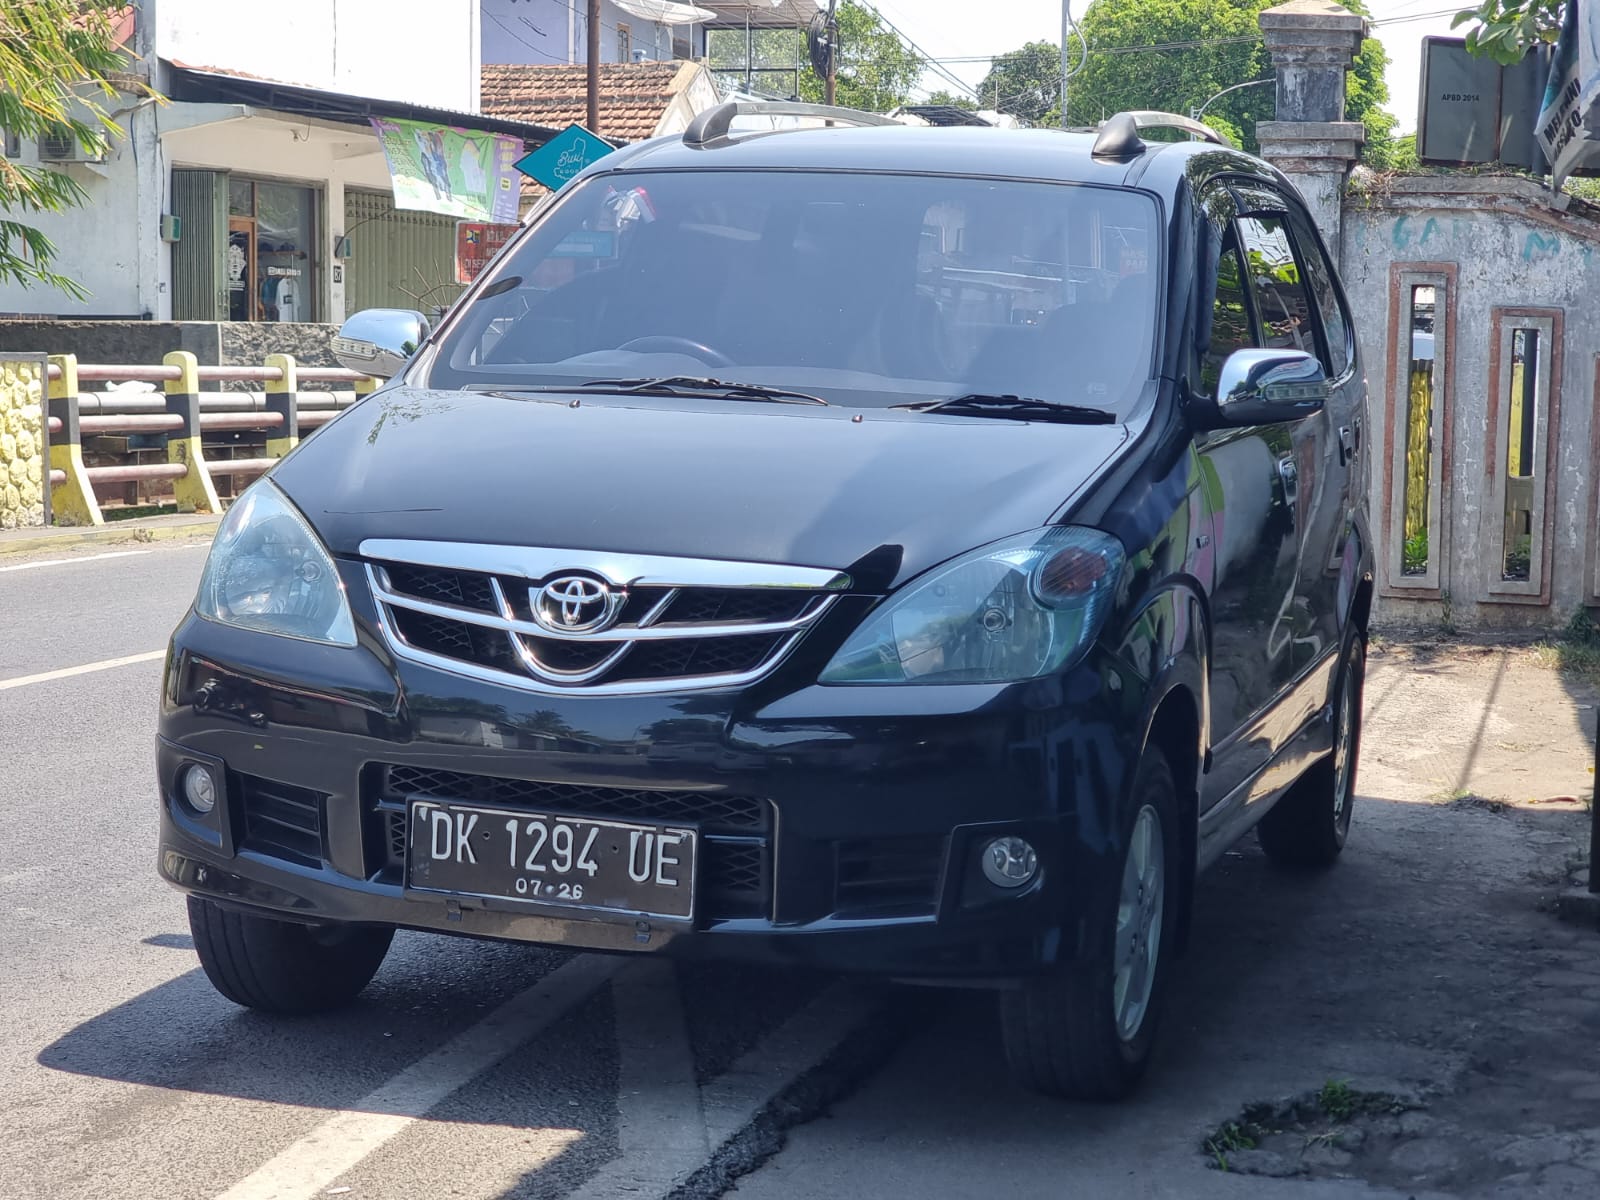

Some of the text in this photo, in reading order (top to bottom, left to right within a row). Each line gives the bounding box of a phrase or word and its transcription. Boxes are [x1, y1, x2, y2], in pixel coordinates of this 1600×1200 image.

[431, 810, 681, 886] DK 1294 UE
